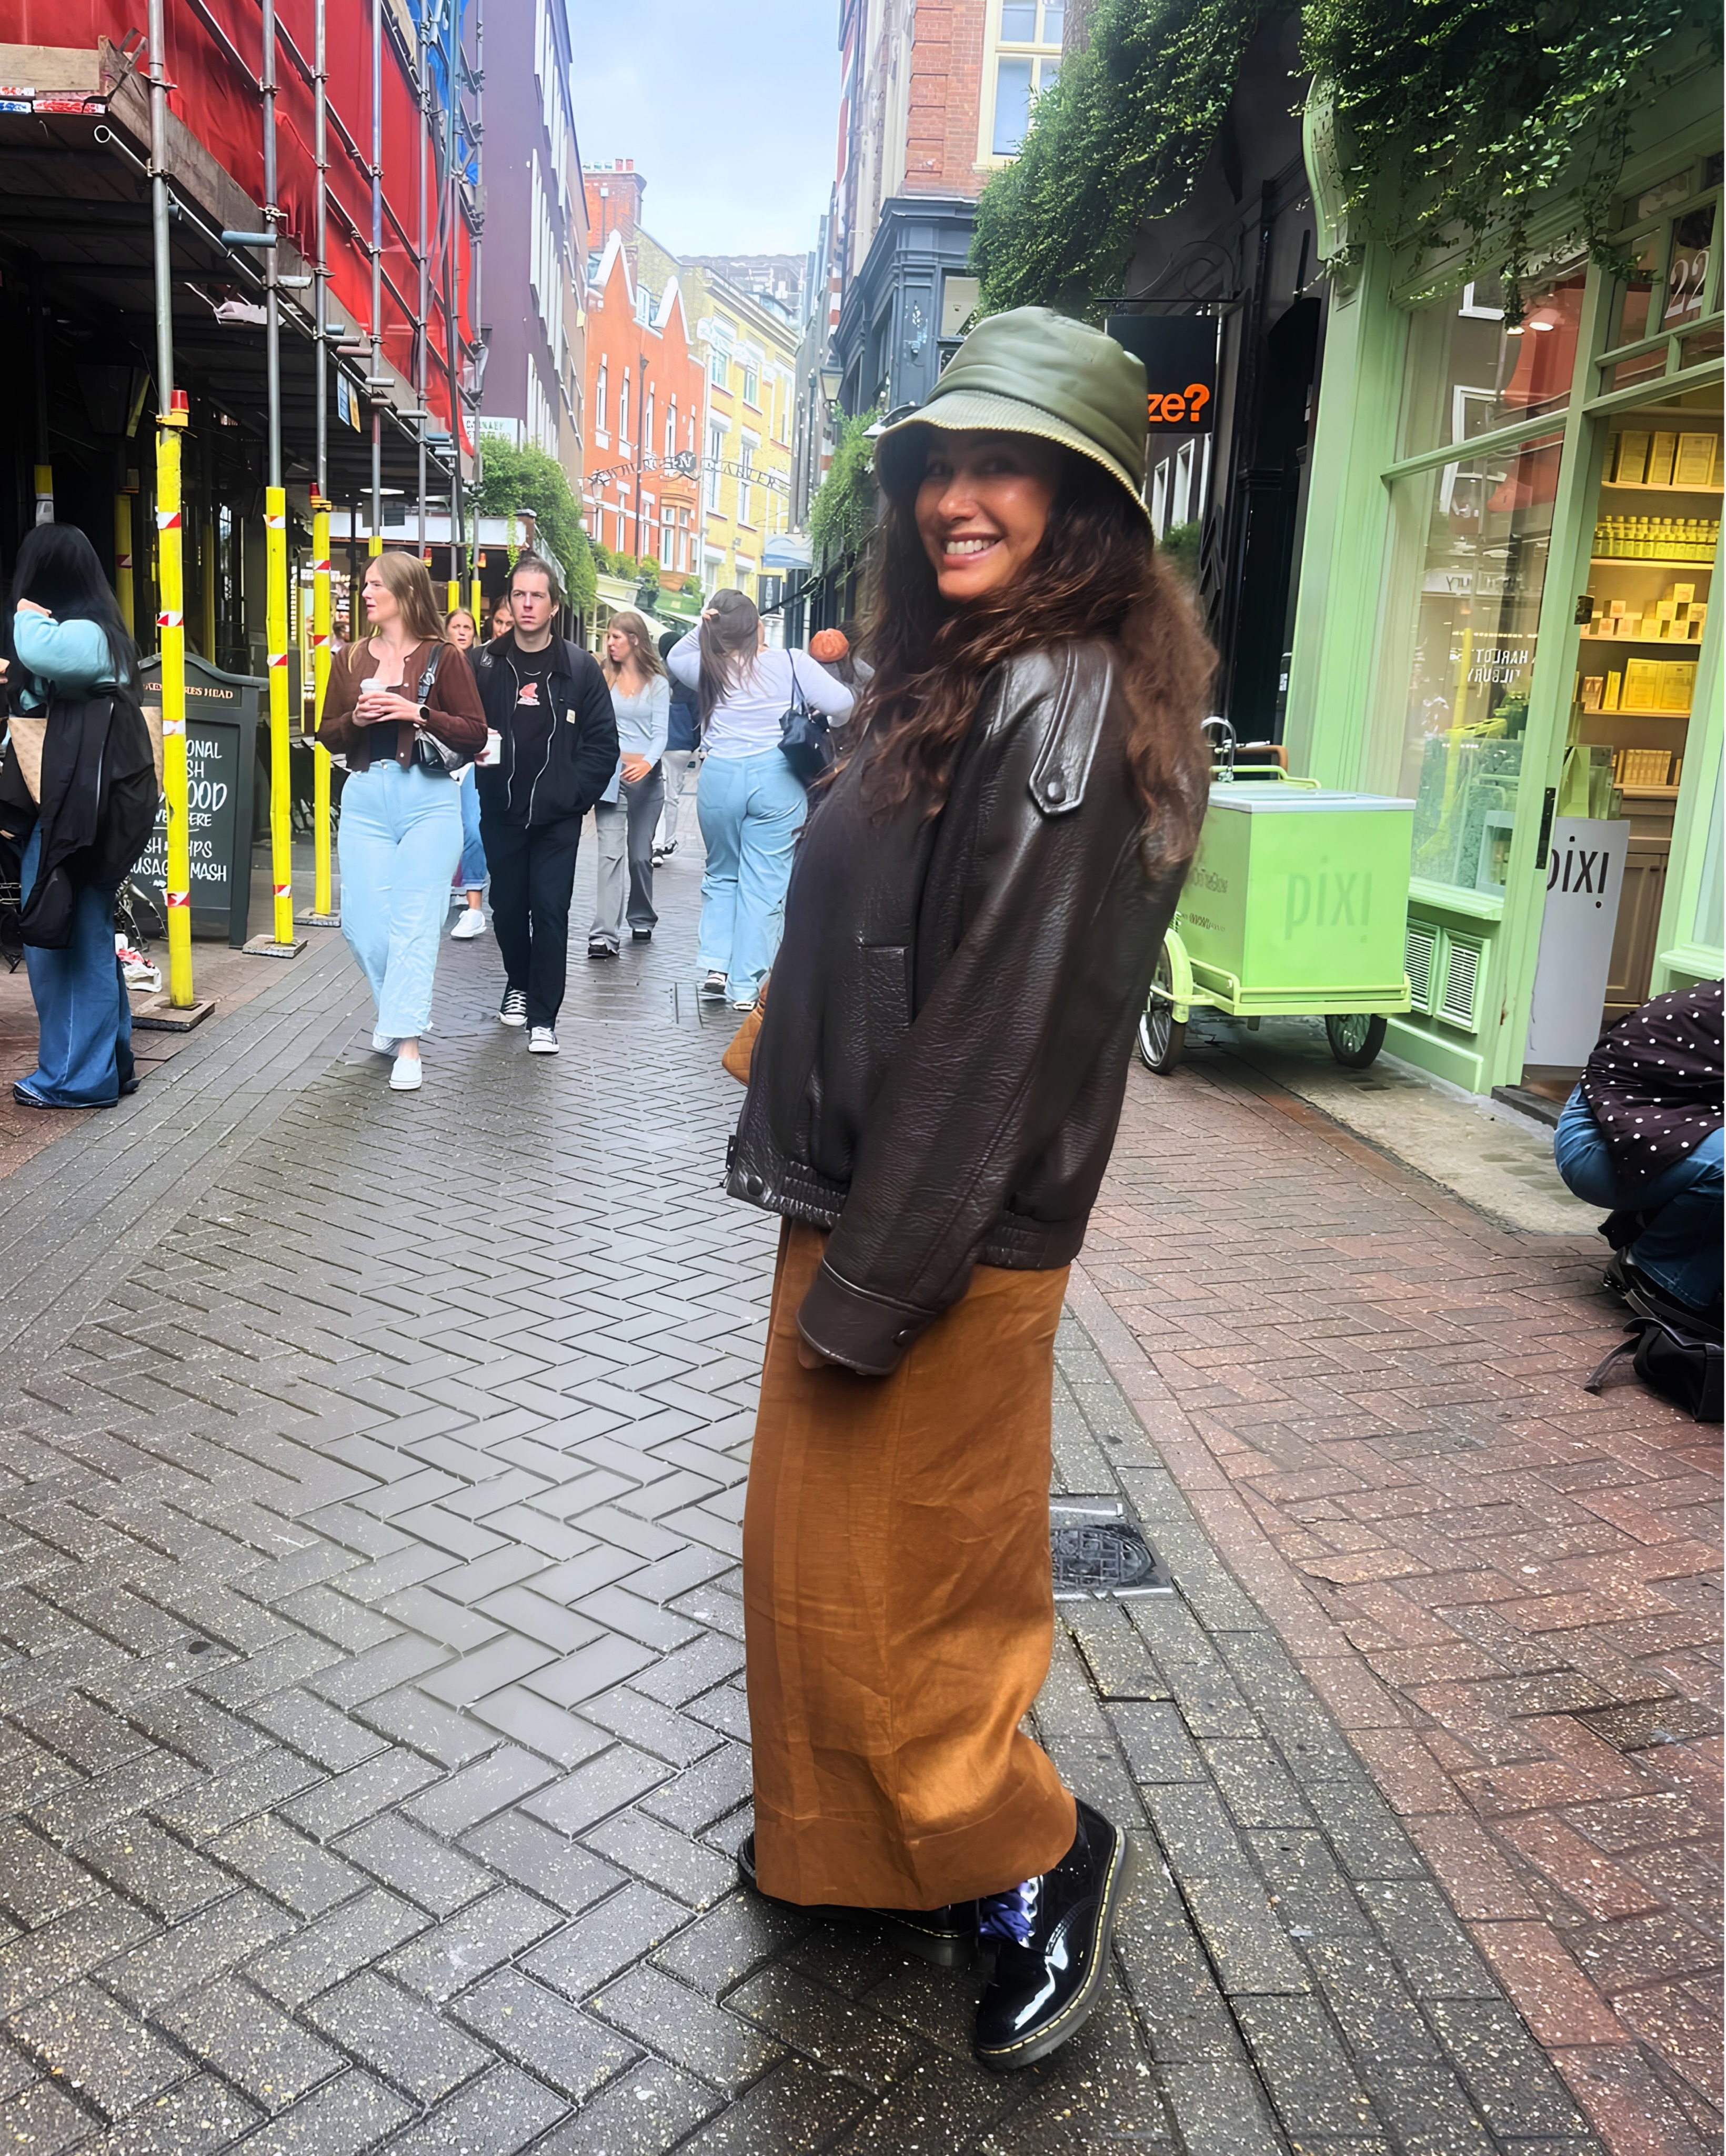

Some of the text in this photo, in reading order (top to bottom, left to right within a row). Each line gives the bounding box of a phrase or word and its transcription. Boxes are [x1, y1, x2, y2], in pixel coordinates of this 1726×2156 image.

[1664, 250, 1709, 318] 22
[1148, 383, 1210, 422] ze?
[204, 688, 233, 698] HEAD
[186, 740, 222, 758] ONAL
[187, 760, 204, 778] SH
[187, 780, 227, 811] OOD
[188, 812, 212, 826] ERE
[144, 837, 162, 854] SH
[131, 857, 227, 882] USAG MASH
